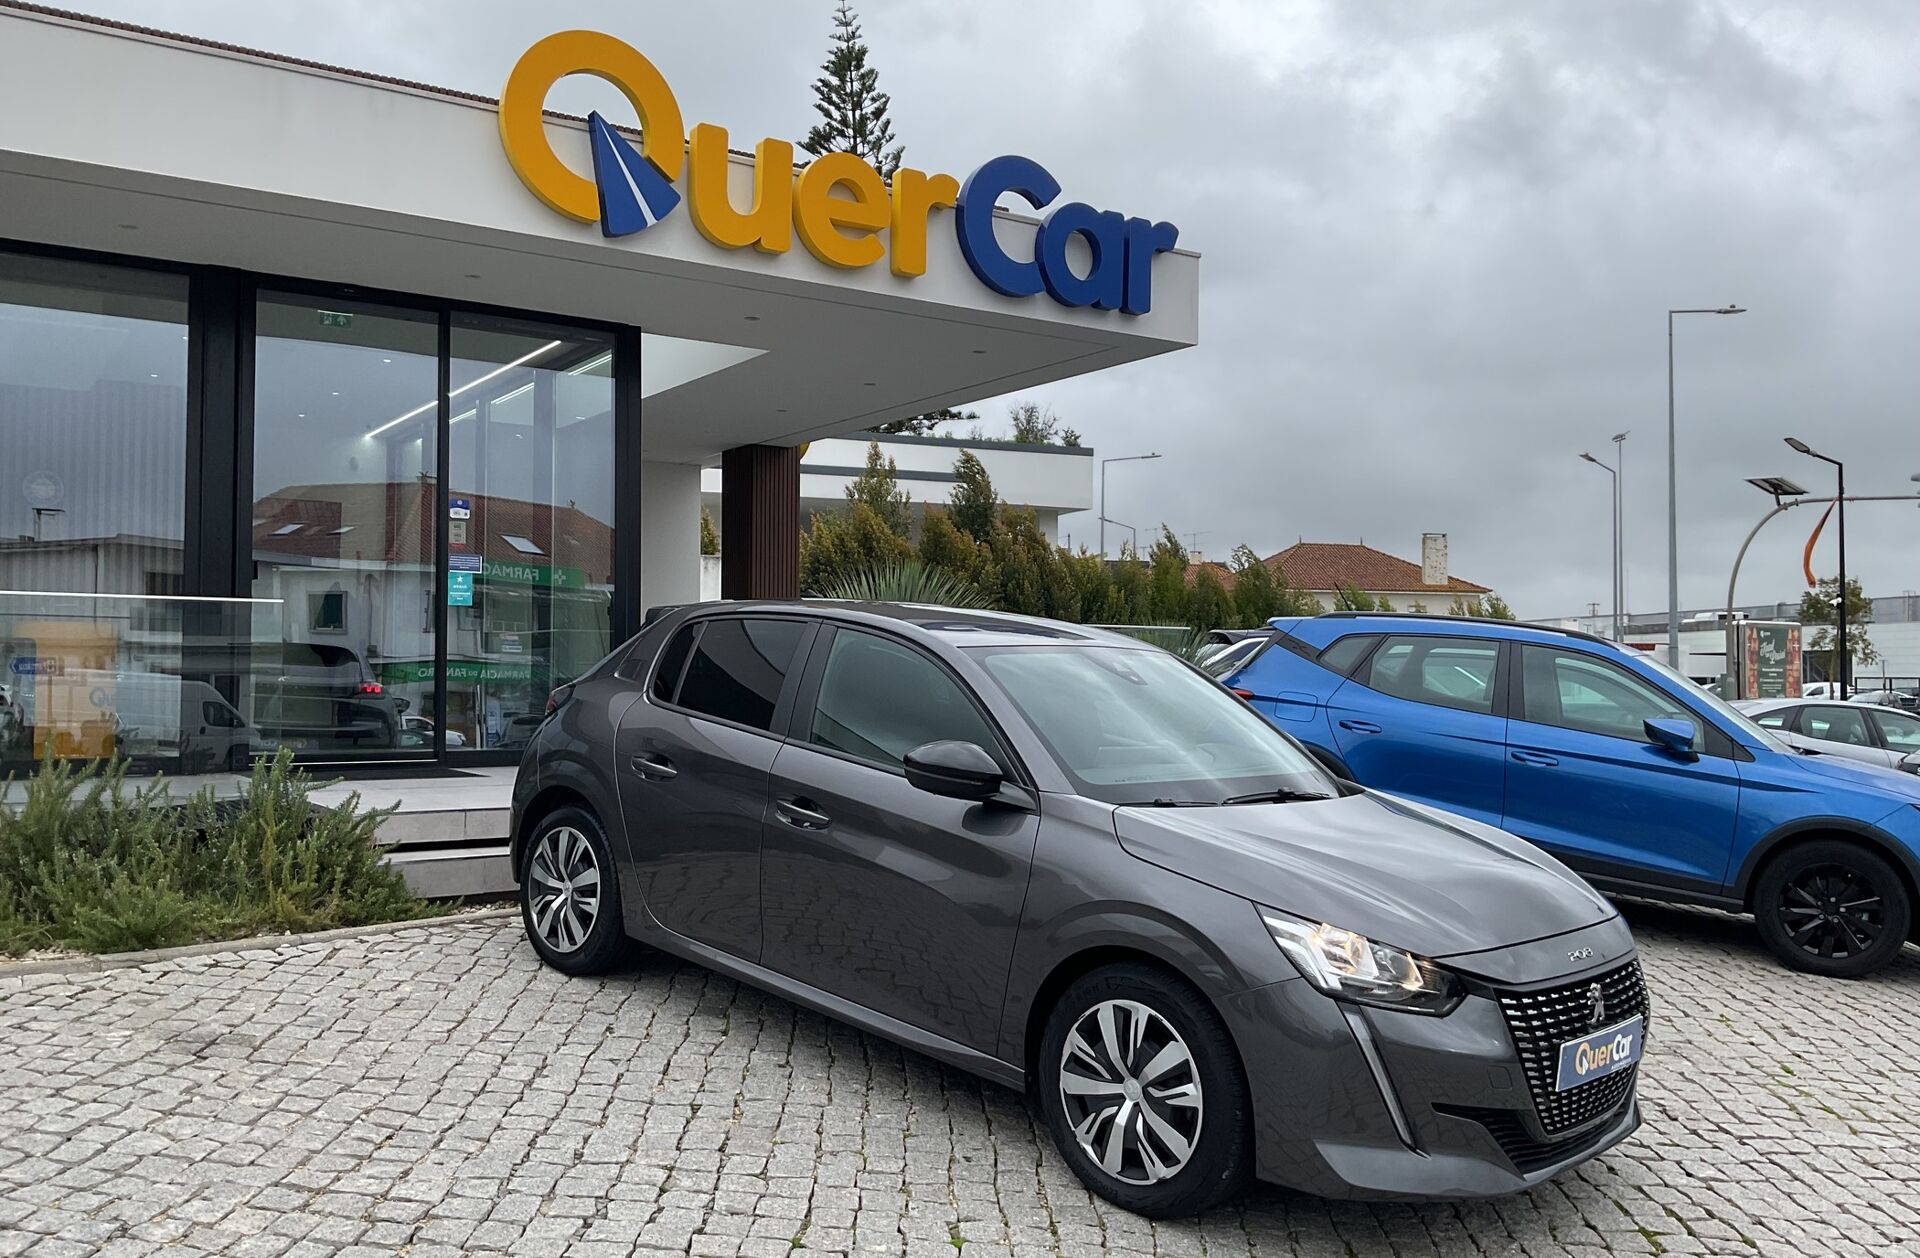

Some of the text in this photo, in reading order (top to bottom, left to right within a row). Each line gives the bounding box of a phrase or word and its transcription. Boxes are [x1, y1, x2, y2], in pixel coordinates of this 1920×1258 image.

[499, 29, 1179, 315] QuerCar
[1568, 947, 1593, 961] 208
[1575, 1034, 1632, 1075] QuerCar
